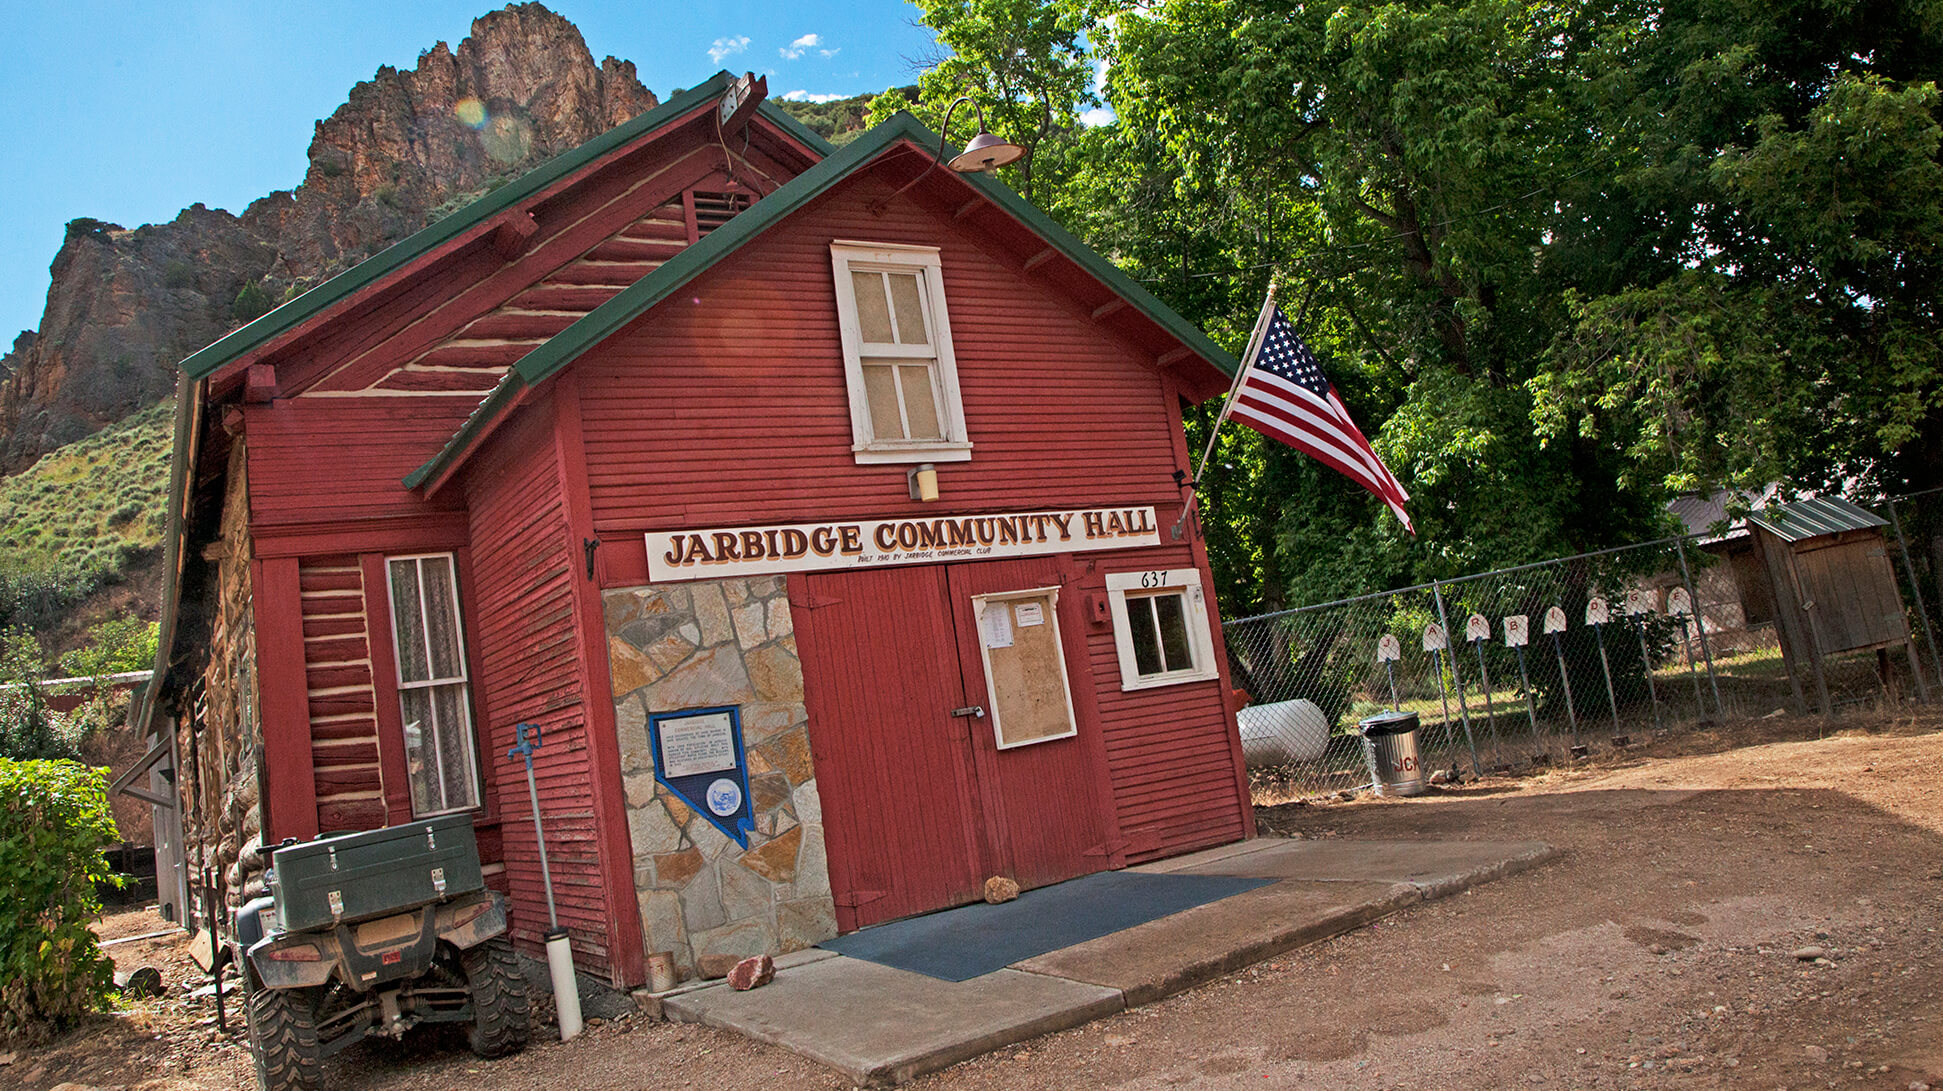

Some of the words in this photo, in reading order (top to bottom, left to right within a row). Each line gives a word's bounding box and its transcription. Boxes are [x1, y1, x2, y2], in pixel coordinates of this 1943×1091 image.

[664, 525, 864, 567] JARBIDGE
[872, 512, 1074, 552] COMMUNITY
[1081, 509, 1157, 540] HALL
[893, 553, 902, 561] BY
[904, 551, 933, 560] JARBIDGE
[937, 549, 972, 557] COMMERCIAL
[1141, 571, 1168, 588] 637
[1428, 626, 1437, 635] A
[1471, 617, 1480, 627] R
[1509, 621, 1519, 631] B
